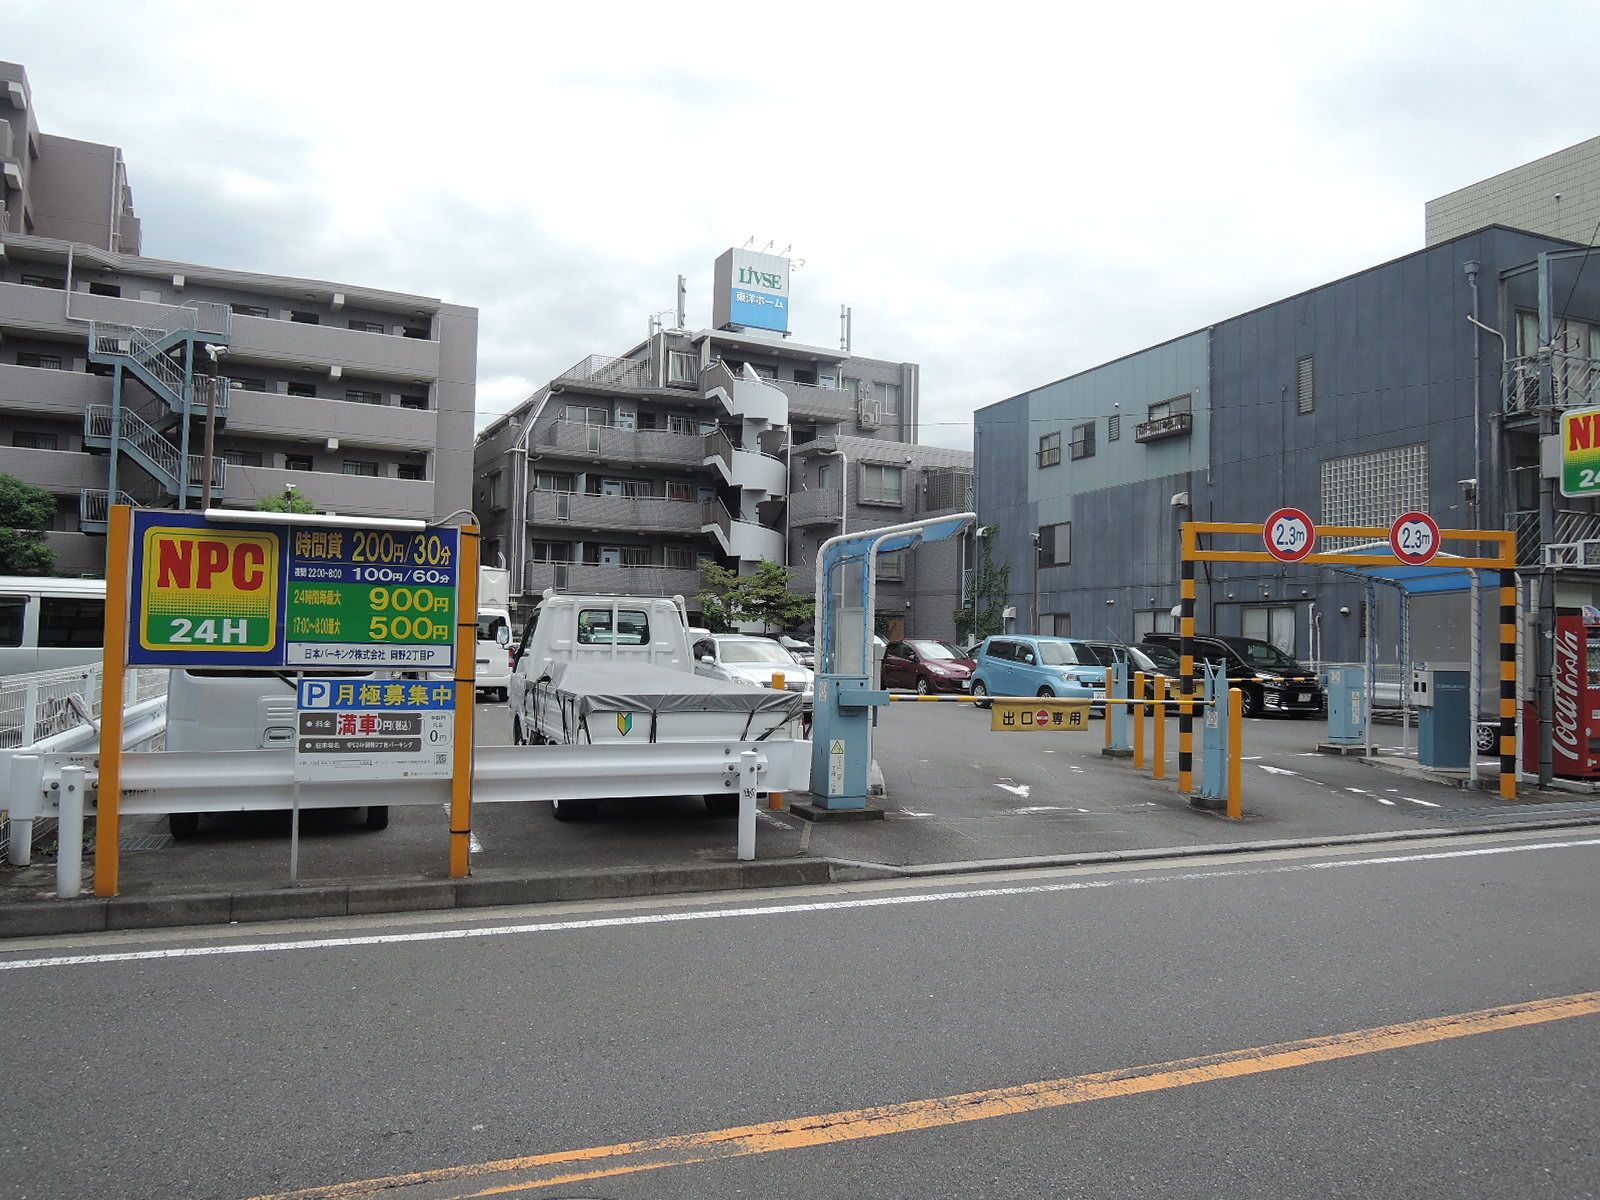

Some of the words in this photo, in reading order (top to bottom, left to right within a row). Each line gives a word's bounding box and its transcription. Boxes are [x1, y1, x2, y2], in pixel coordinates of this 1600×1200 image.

[1579, 469, 1600, 488] 2
[1276, 523, 1305, 546] 2.3m
[1402, 527, 1430, 549] 2.3m
[295, 532, 343, 559] 時間貸
[352, 531, 452, 565] 200円/30分
[157, 538, 265, 592] NPC
[352, 567, 450, 583] 100円/60分
[293, 589, 341, 606] 24時間毎最大
[369, 587, 449, 612] 900円
[169, 617, 248, 644] 24H
[368, 616, 448, 640] 500円
[304, 648, 386, 661] 日本パーキング株式会社
[335, 683, 452, 706] 月極募集中
[337, 713, 378, 736] 満車
[1003, 710, 1033, 726] 出口
[1051, 711, 1081, 726] 専用
